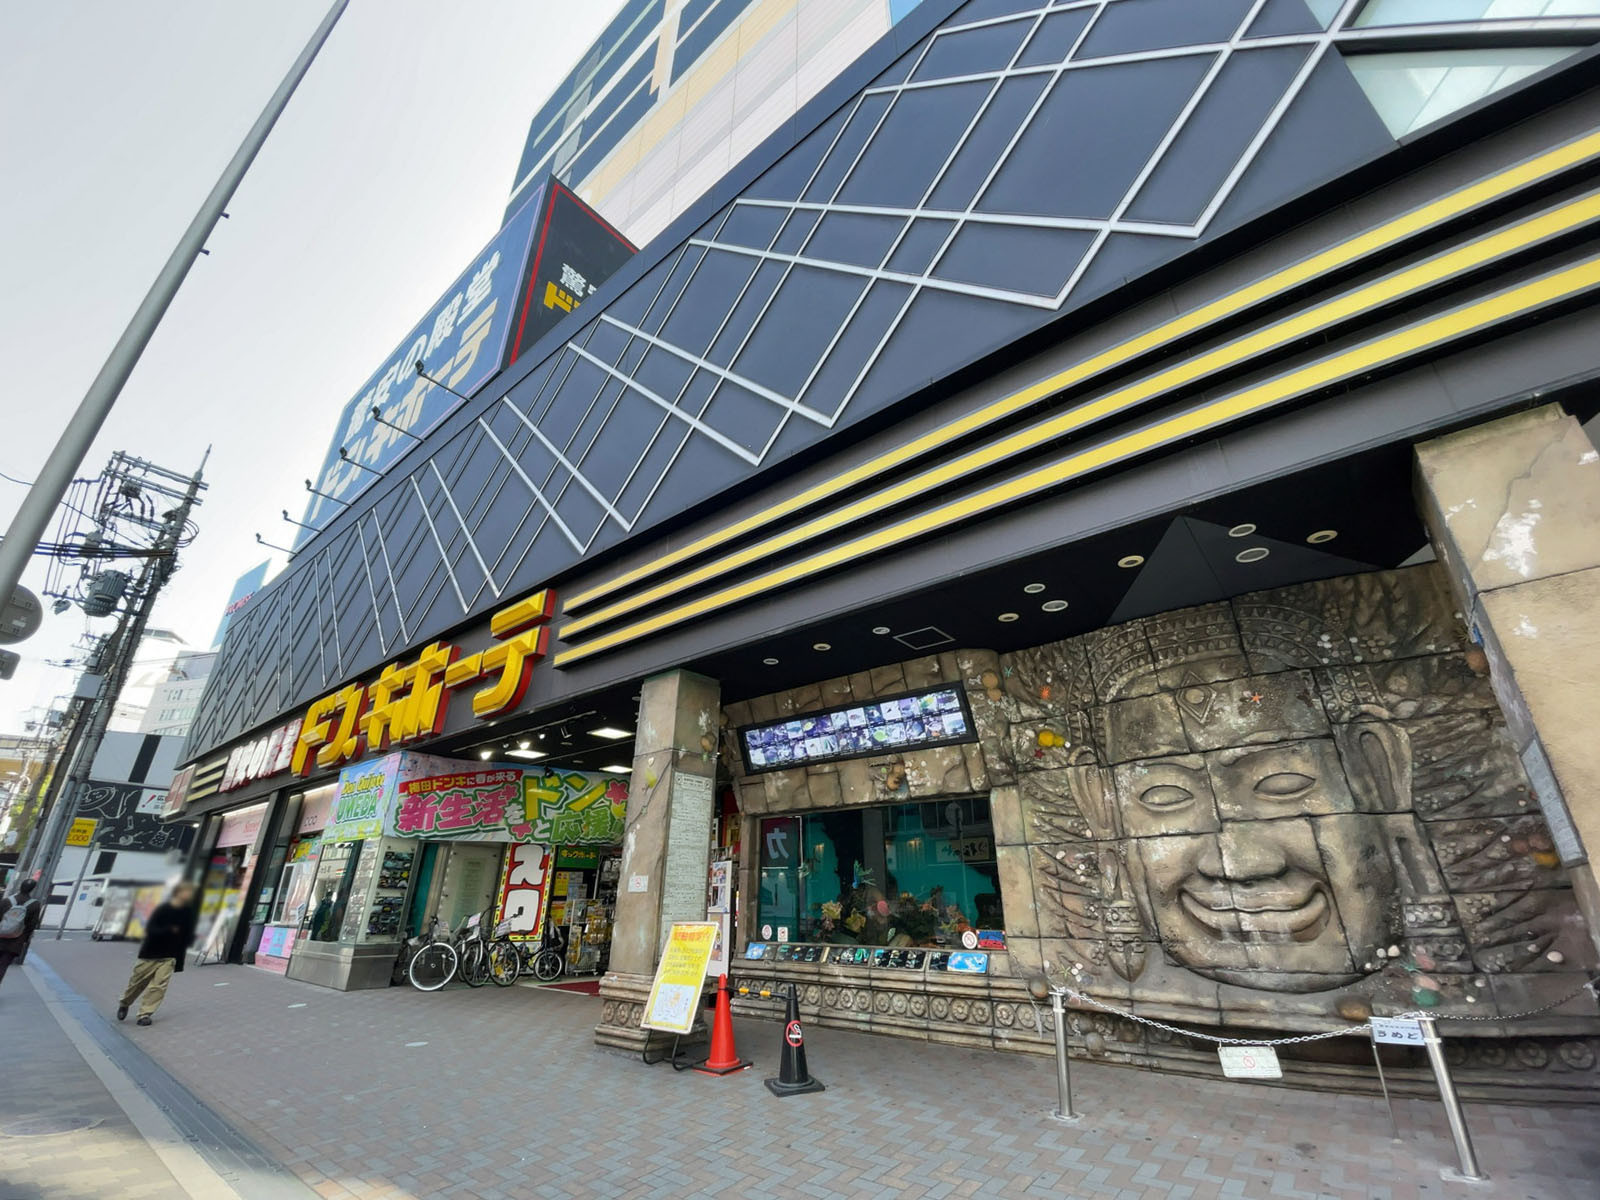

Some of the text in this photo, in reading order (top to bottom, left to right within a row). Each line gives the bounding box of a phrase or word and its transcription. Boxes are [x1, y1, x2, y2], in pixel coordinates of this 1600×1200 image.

[408, 771, 516, 794] 梅田ドンキに春が来る
